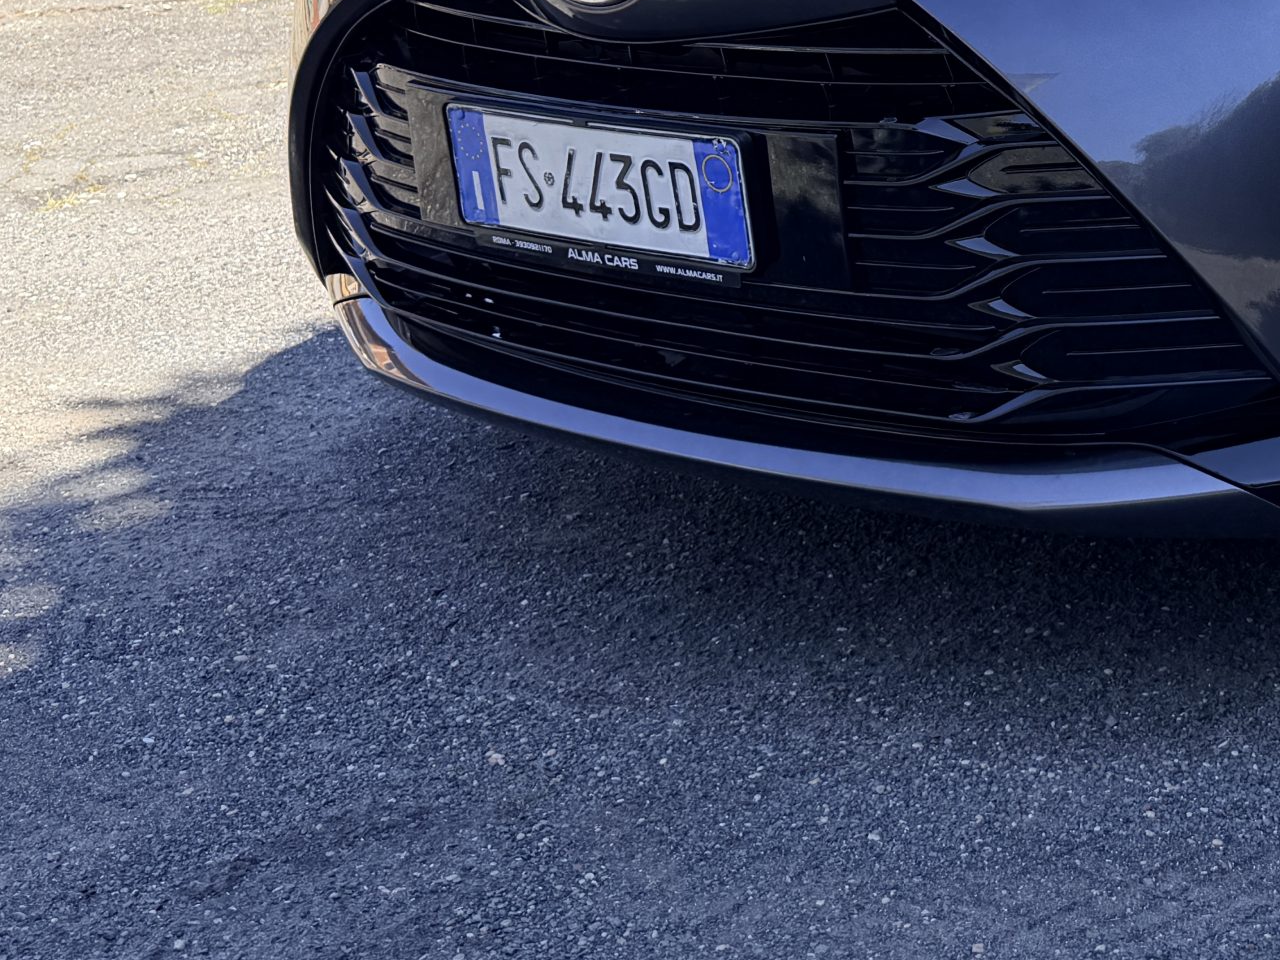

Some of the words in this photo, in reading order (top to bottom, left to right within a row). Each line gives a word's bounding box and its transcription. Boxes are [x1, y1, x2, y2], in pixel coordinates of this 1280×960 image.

[567, 247, 603, 265] ALMA
[604, 253, 639, 270] CARS
[654, 263, 724, 283] WWW.ALMACARS.IT
